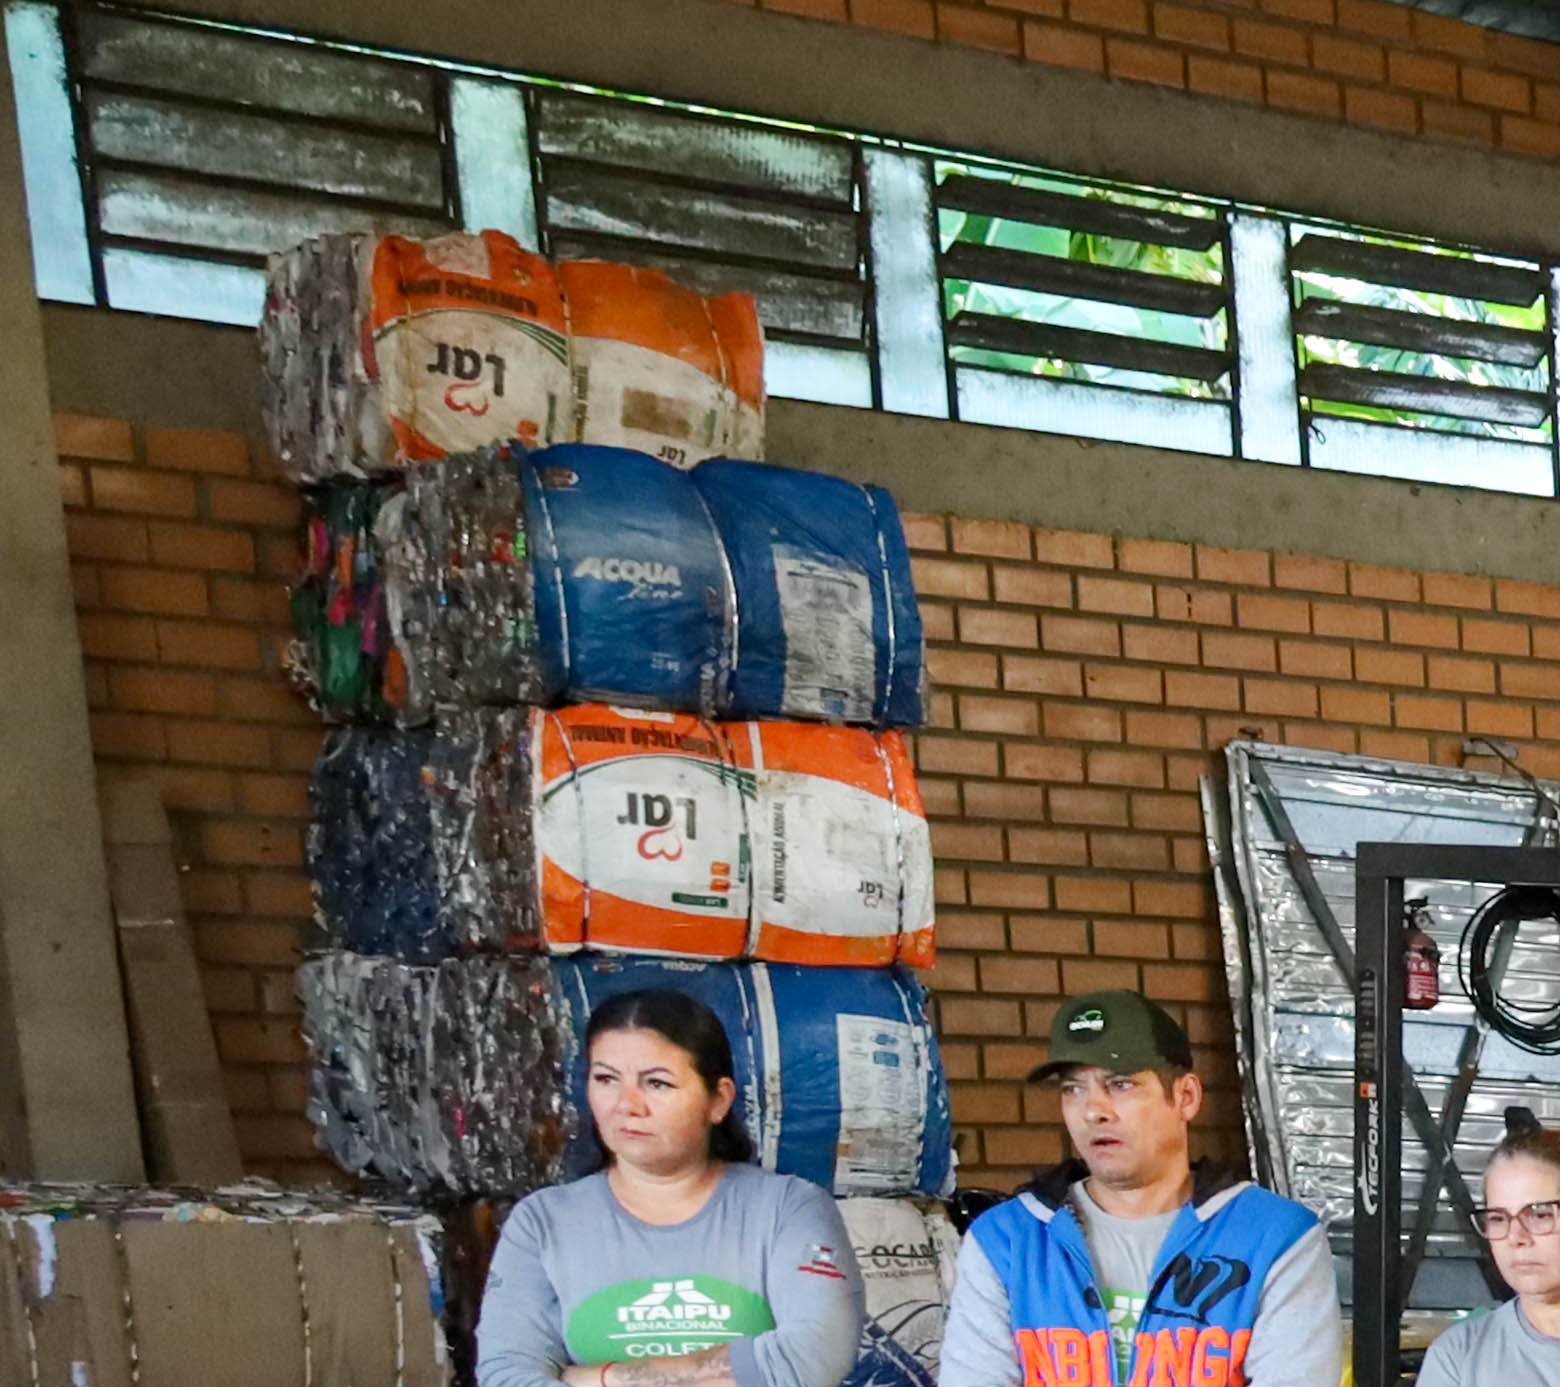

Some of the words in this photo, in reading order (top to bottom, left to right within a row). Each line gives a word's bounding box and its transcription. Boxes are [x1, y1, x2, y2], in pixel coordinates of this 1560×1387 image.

[427, 342, 506, 397] Lar
[572, 556, 681, 587] ACQUA
[617, 791, 697, 841] Lar
[857, 879, 884, 900] Lar
[1366, 1098, 1380, 1197] TECFORK
[616, 1303, 731, 1323] ITAIPU
[624, 1319, 729, 1332] BINACIONAL
